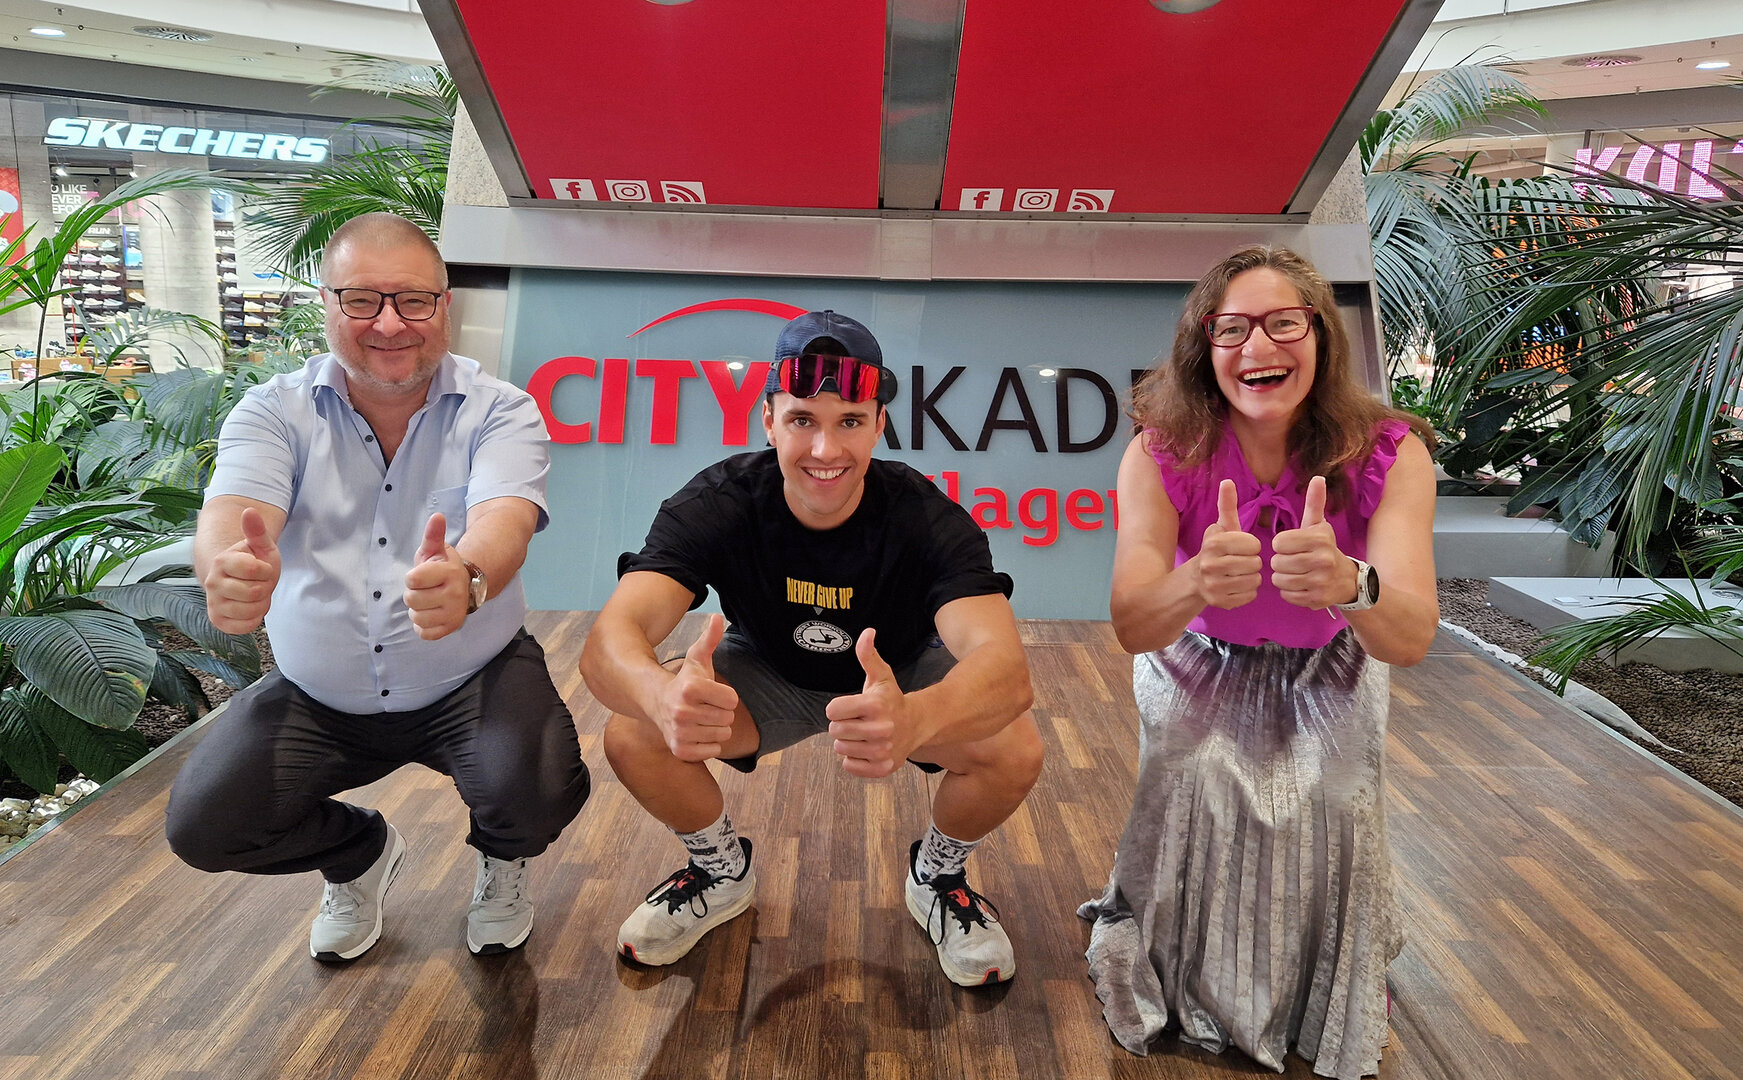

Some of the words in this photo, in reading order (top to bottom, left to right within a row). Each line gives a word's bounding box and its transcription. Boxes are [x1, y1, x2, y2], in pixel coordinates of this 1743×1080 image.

[44, 117, 329, 163] SKECHERS
[51, 194, 82, 205] EVER
[61, 184, 88, 195] LIKE
[526, 356, 771, 446] CITY
[924, 471, 1119, 547] lage
[786, 576, 816, 606] NEVER
[816, 584, 838, 609] GIVE
[838, 586, 854, 610] UP
